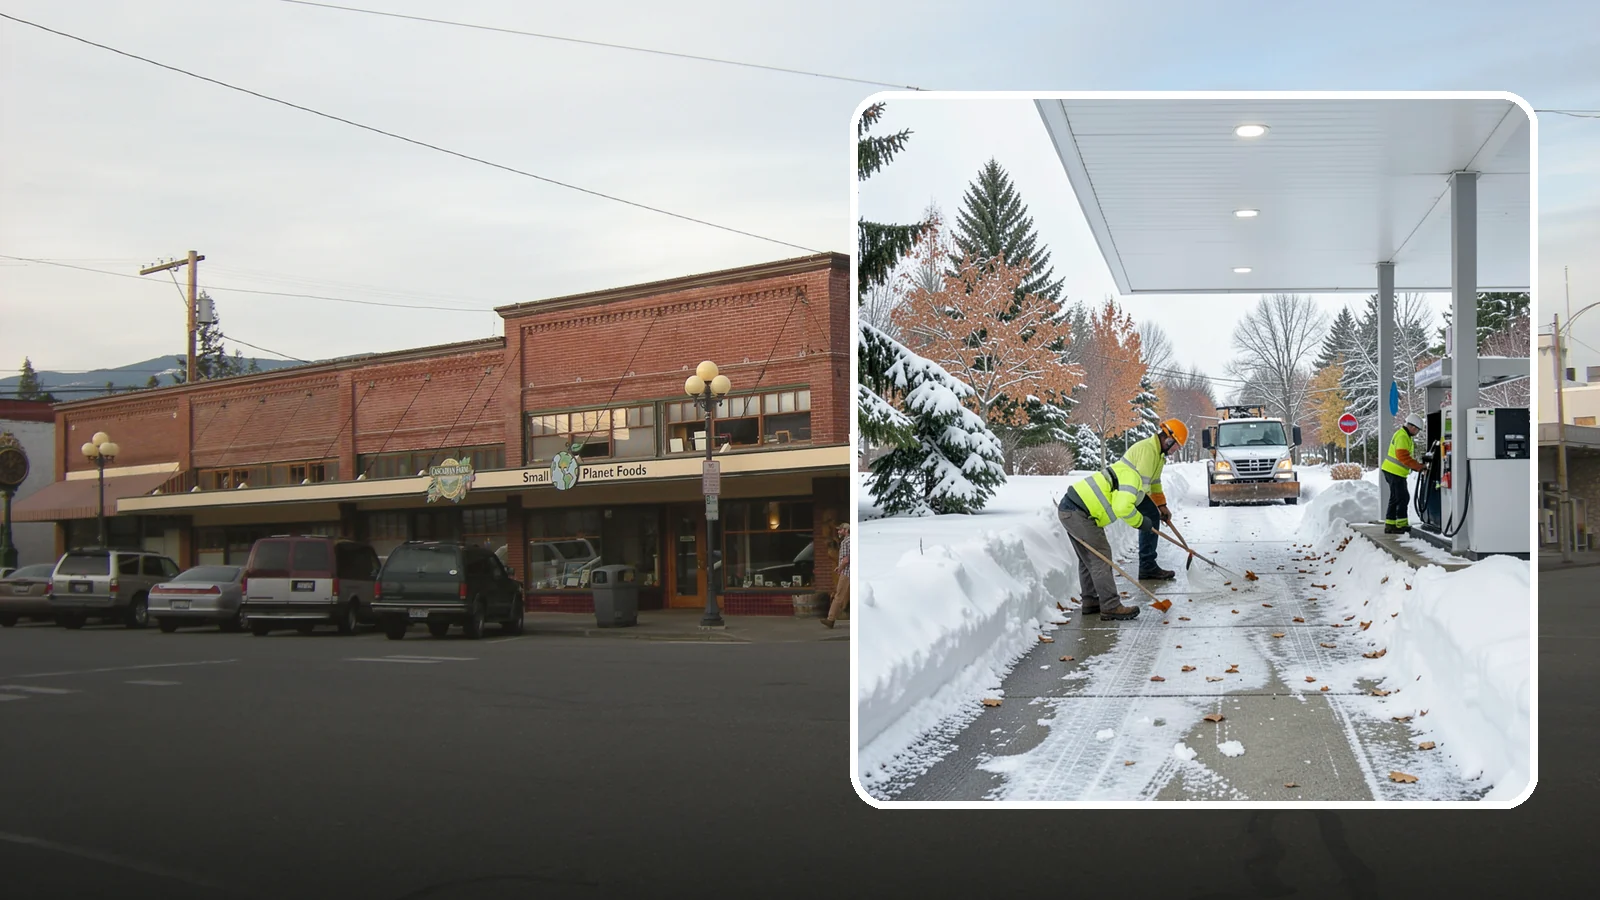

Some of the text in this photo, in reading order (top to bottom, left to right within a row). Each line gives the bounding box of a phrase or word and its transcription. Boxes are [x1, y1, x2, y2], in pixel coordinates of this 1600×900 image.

[523, 464, 647, 483] Small Planet Foods
